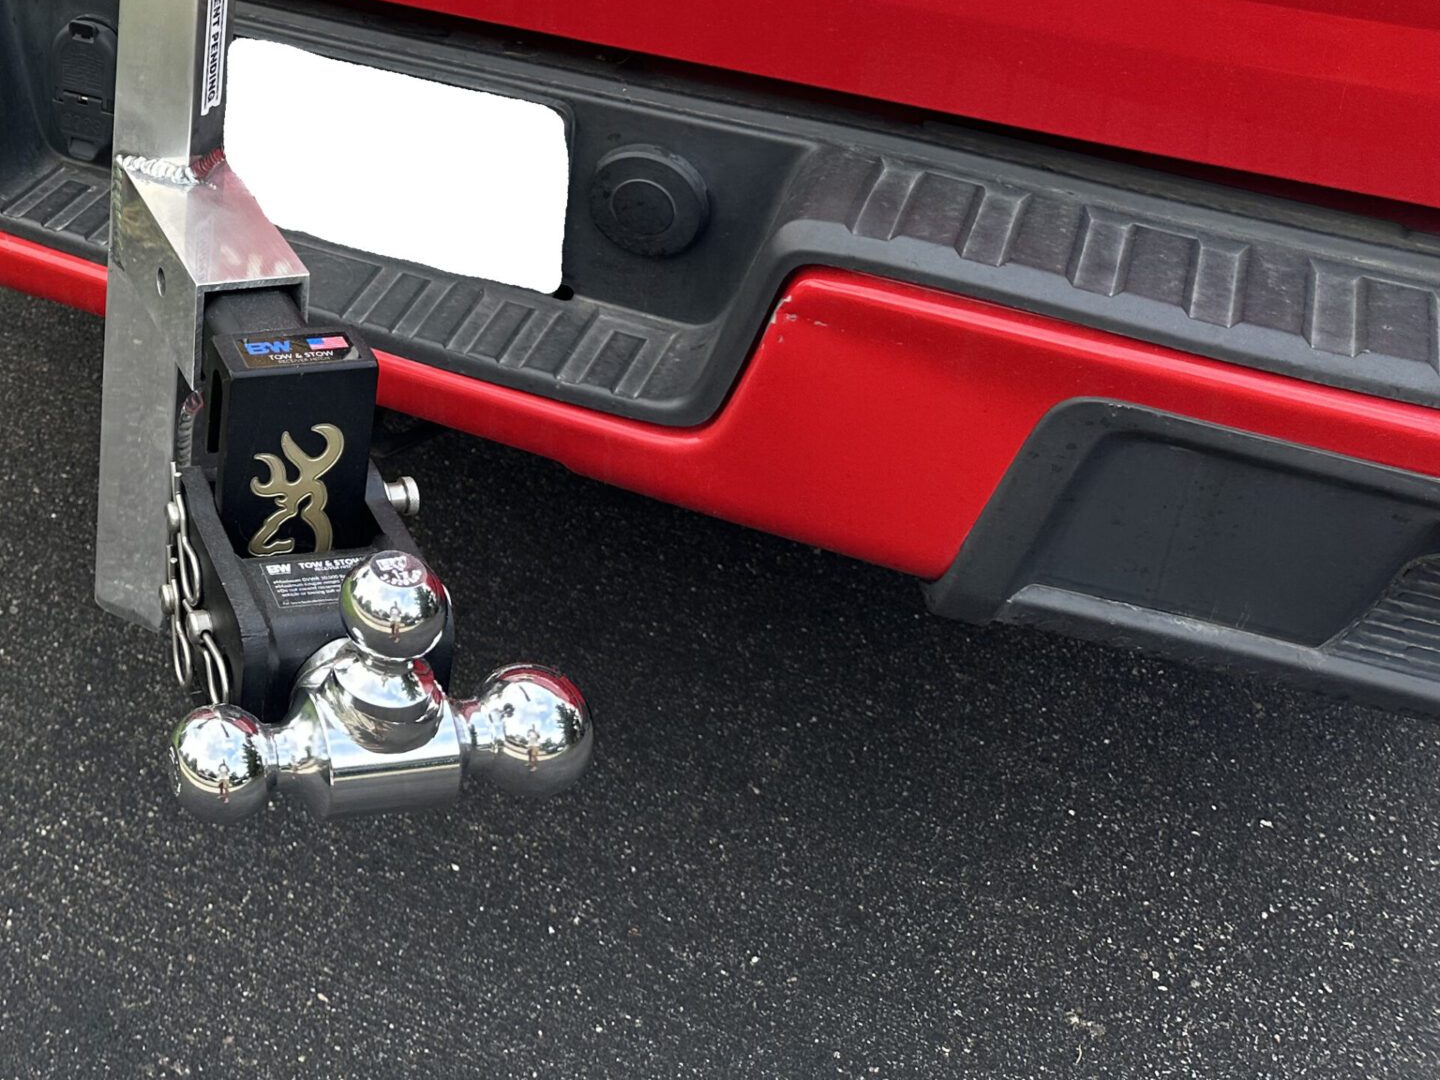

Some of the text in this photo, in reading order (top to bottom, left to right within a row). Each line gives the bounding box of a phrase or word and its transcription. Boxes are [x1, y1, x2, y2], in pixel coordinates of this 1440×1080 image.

[208, 33, 220, 103] PENDING
[268, 353, 293, 361] TOW
[304, 350, 334, 358] STOW
[298, 561, 323, 570] TOW
[324, 559, 333, 567] &
